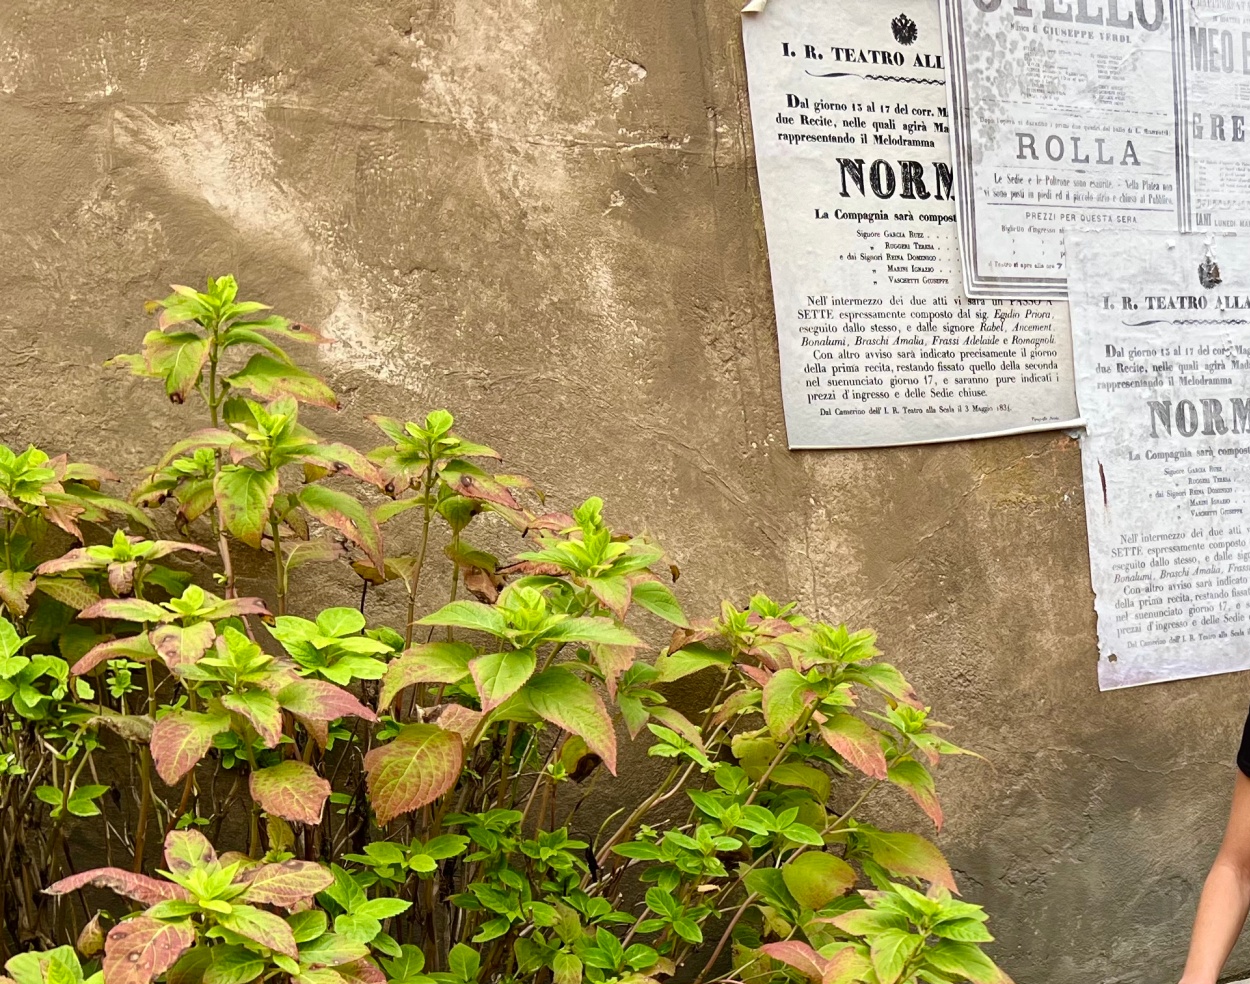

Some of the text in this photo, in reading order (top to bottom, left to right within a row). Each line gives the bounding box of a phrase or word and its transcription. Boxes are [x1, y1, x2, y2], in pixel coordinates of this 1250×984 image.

[781, 42, 945, 69] I. R. TEATRO ALL
[1189, 26, 1234, 74] MEO
[786, 94, 809, 109] Dal
[814, 100, 847, 113] giorno
[880, 104, 890, 113] 17
[894, 103, 908, 115] del
[912, 107, 935, 117] corr.
[776, 113, 927, 135] due Recite, nelle quali agirà
[778, 132, 935, 147] rappresentando Melodramma
[1016, 132, 1141, 166] ROLLA
[836, 158, 955, 201] NORM
[814, 209, 956, 226] La Compagnia sarà compost
[1026, 212, 1055, 220] PREZZI
[1061, 213, 1076, 221] PER
[1081, 214, 1112, 222] QUESTA
[832, 296, 947, 306] intermezzo dei due atti
[1103, 298, 1114, 310] I.
[1122, 297, 1138, 310] R.
[1145, 296, 1208, 310] TEATRO
[798, 309, 1020, 322] SETTE espressamente composto dal Egidio
[799, 323, 974, 335] eseguito dallo stesso, dalle signore
[855, 336, 889, 346] Braschi
[894, 336, 927, 346] Amalia,
[932, 335, 959, 346] Frassi
[963, 335, 999, 345] Adelaide
[813, 349, 1057, 361] Con altro avviso sarà indicato precisamente giorno
[1105, 344, 1124, 358] Dal
[1128, 347, 1157, 359] giorno
[804, 361, 1058, 376] della prima recita, restando fissato quello della seconda
[1117, 363, 1147, 374] Recite,
[1152, 362, 1173, 372] nelle
[1178, 361, 1198, 373] quali
[1205, 359, 1226, 372] agirà
[827, 376, 883, 386] suenunciato
[890, 376, 918, 389] giorno
[924, 375, 937, 385] 17,
[996, 376, 1015, 388] pure
[1021, 374, 1051, 383] indicati
[1097, 376, 1232, 392] rappresentando Melodramma
[808, 390, 836, 404] prezzi
[905, 388, 926, 398] delle
[930, 388, 954, 397] Sedie
[959, 388, 988, 397] chiuse.
[1129, 451, 1140, 461] La
[1145, 450, 1192, 462] Compagnia
[1197, 447, 1214, 457] sarà
